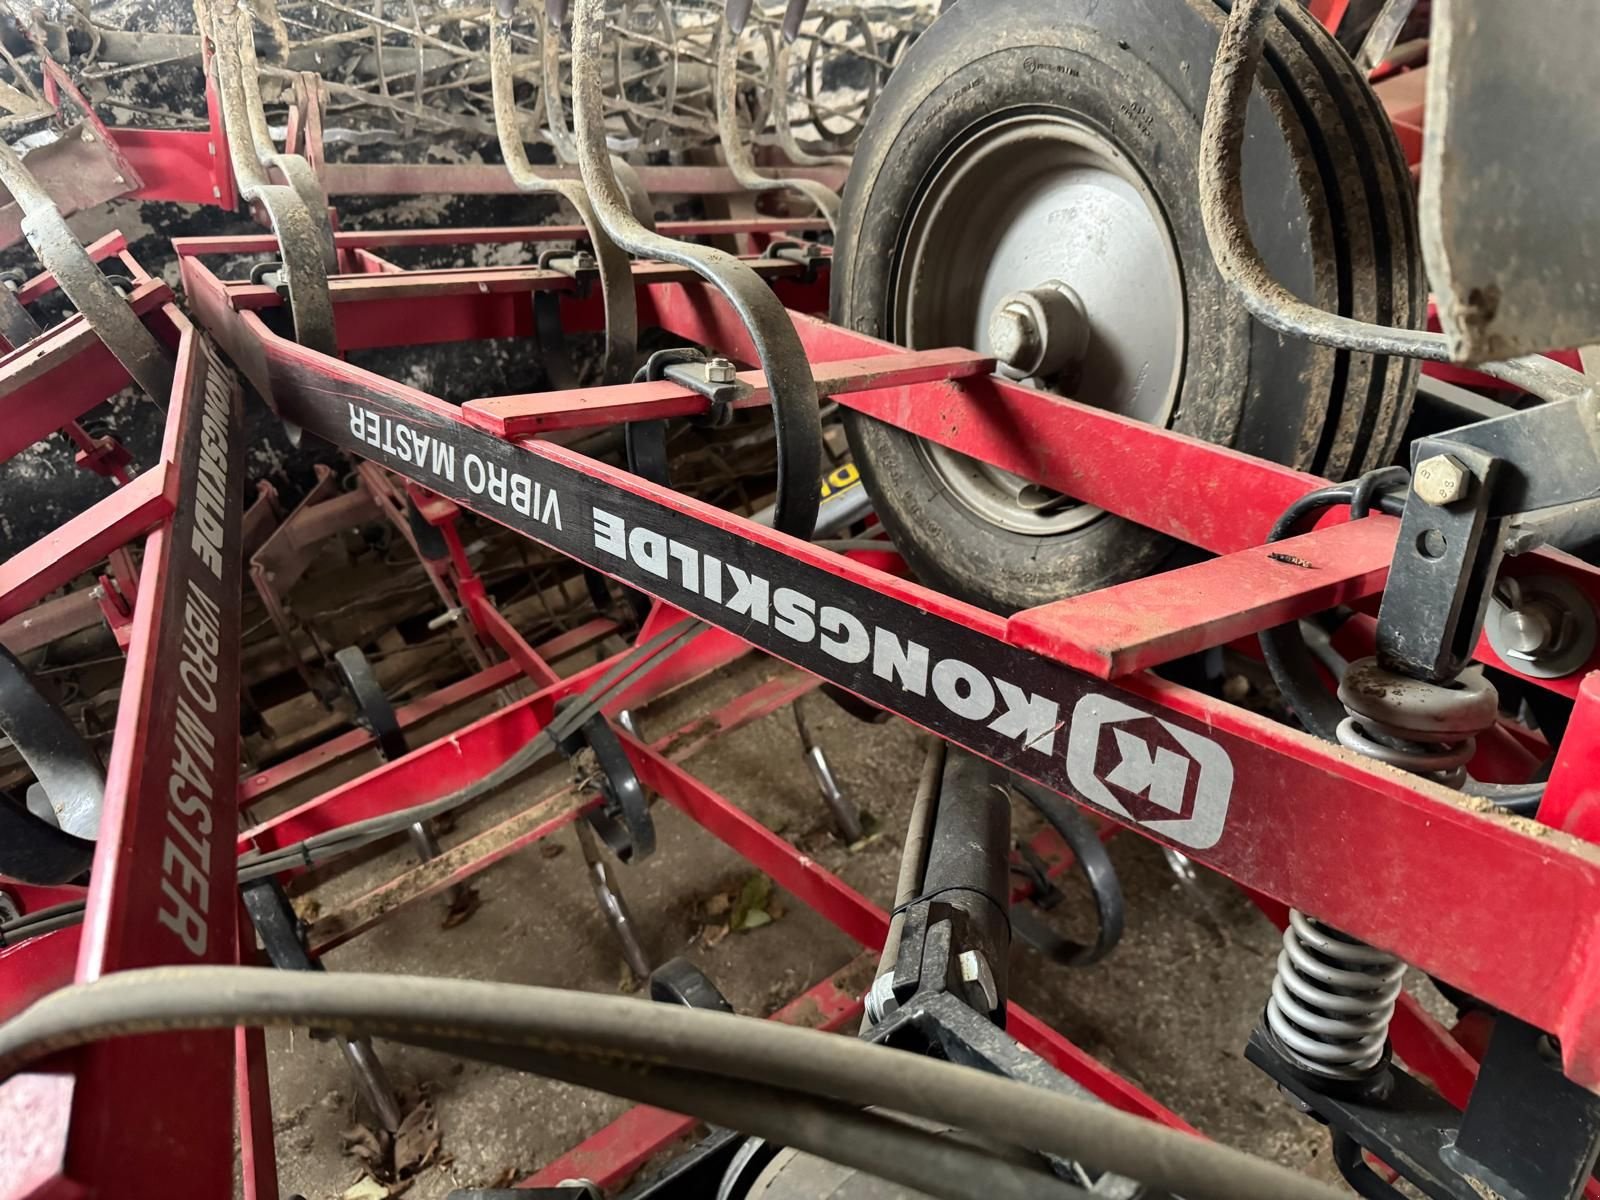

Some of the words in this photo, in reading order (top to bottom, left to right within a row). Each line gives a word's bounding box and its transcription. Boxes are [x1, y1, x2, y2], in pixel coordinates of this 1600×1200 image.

[191, 362, 231, 581] KONGSKILDE
[348, 402, 455, 483] MASTER
[463, 453, 562, 531] VIBRO
[179, 579, 221, 713] VIBRO
[593, 506, 1060, 755] KONGSKILDE
[157, 695, 216, 956] MASTER
[1106, 726, 1191, 814] K
